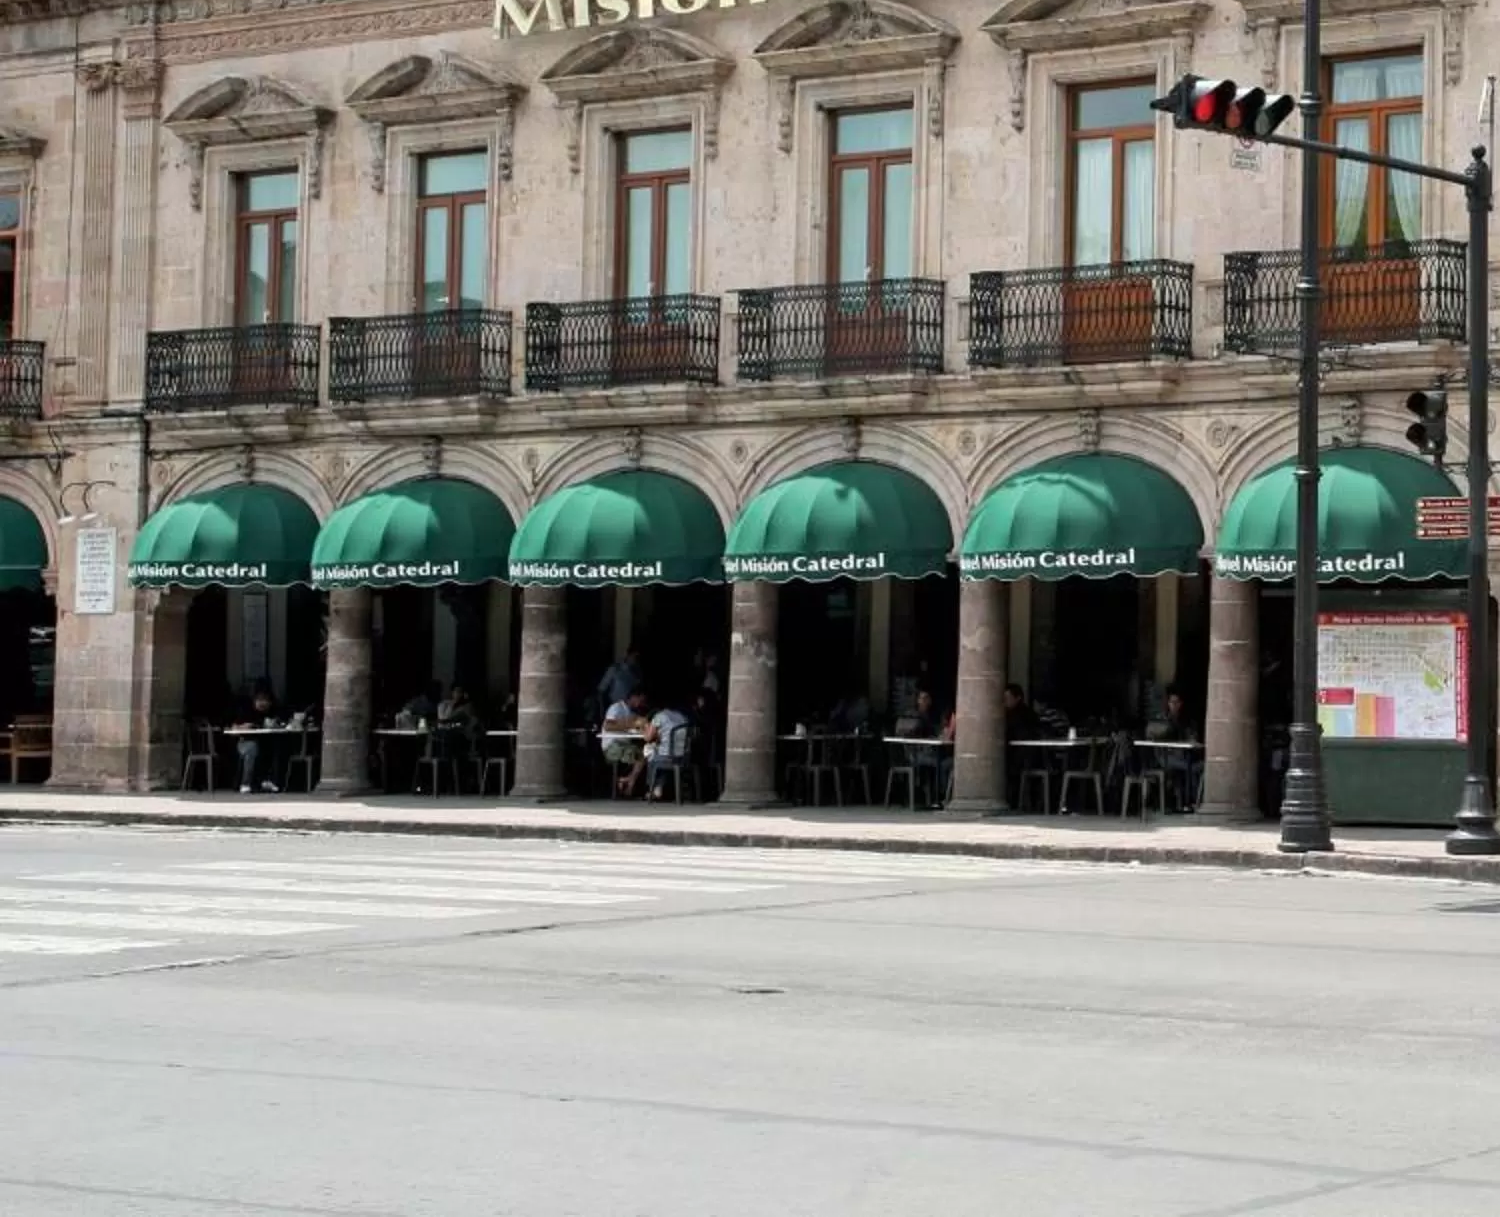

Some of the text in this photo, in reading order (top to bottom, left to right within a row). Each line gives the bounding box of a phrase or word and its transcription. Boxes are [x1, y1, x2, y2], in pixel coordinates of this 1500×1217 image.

[741, 557, 789, 573] Misión
[792, 552, 885, 572] Catedral
[982, 552, 1035, 569] Misión
[1039, 548, 1135, 568] Catedral
[1316, 551, 1405, 572] atedral
[181, 562, 267, 578] Catedral
[326, 565, 369, 580] Misión
[372, 560, 459, 578] Catedral
[523, 562, 570, 578] Misión
[573, 560, 662, 578] Catedral
